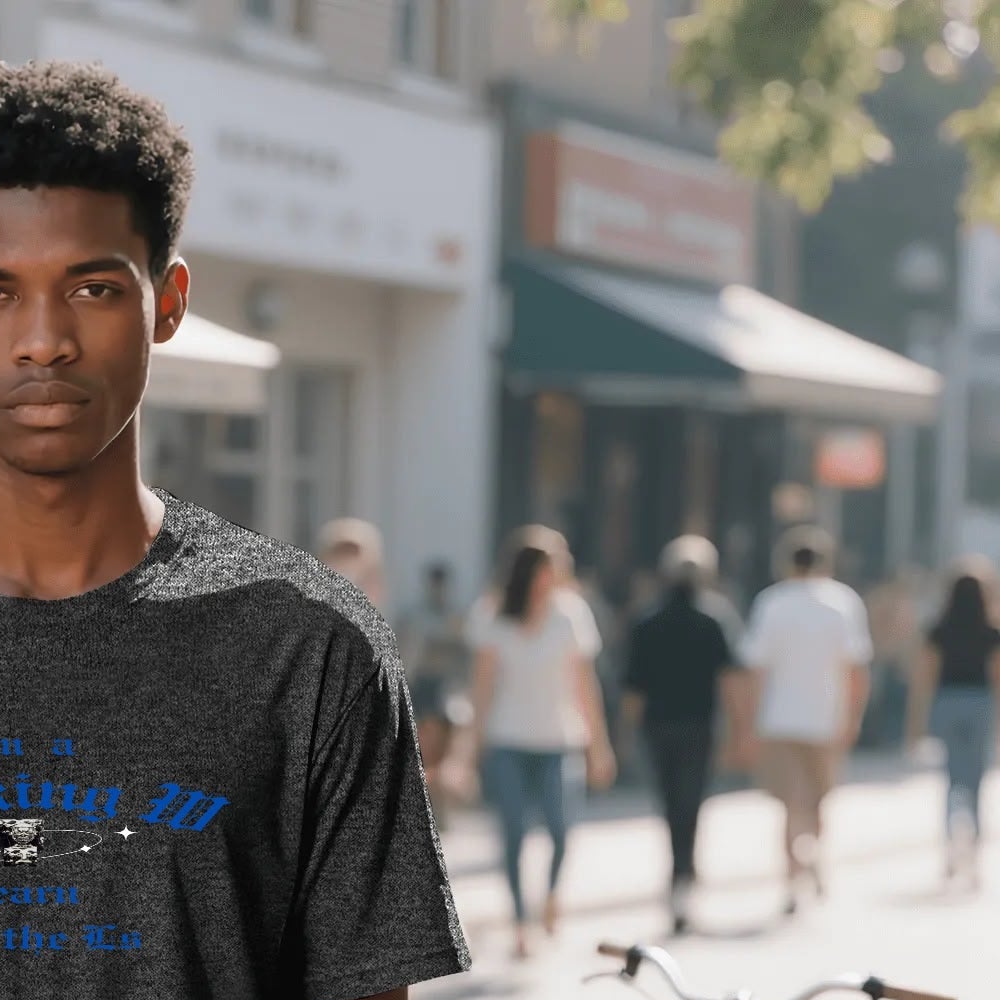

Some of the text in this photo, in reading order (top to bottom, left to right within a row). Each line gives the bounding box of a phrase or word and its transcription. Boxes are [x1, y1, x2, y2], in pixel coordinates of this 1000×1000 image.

[51, 737, 74, 757] a
[139, 783, 230, 832] W
[3, 925, 68, 956] the
